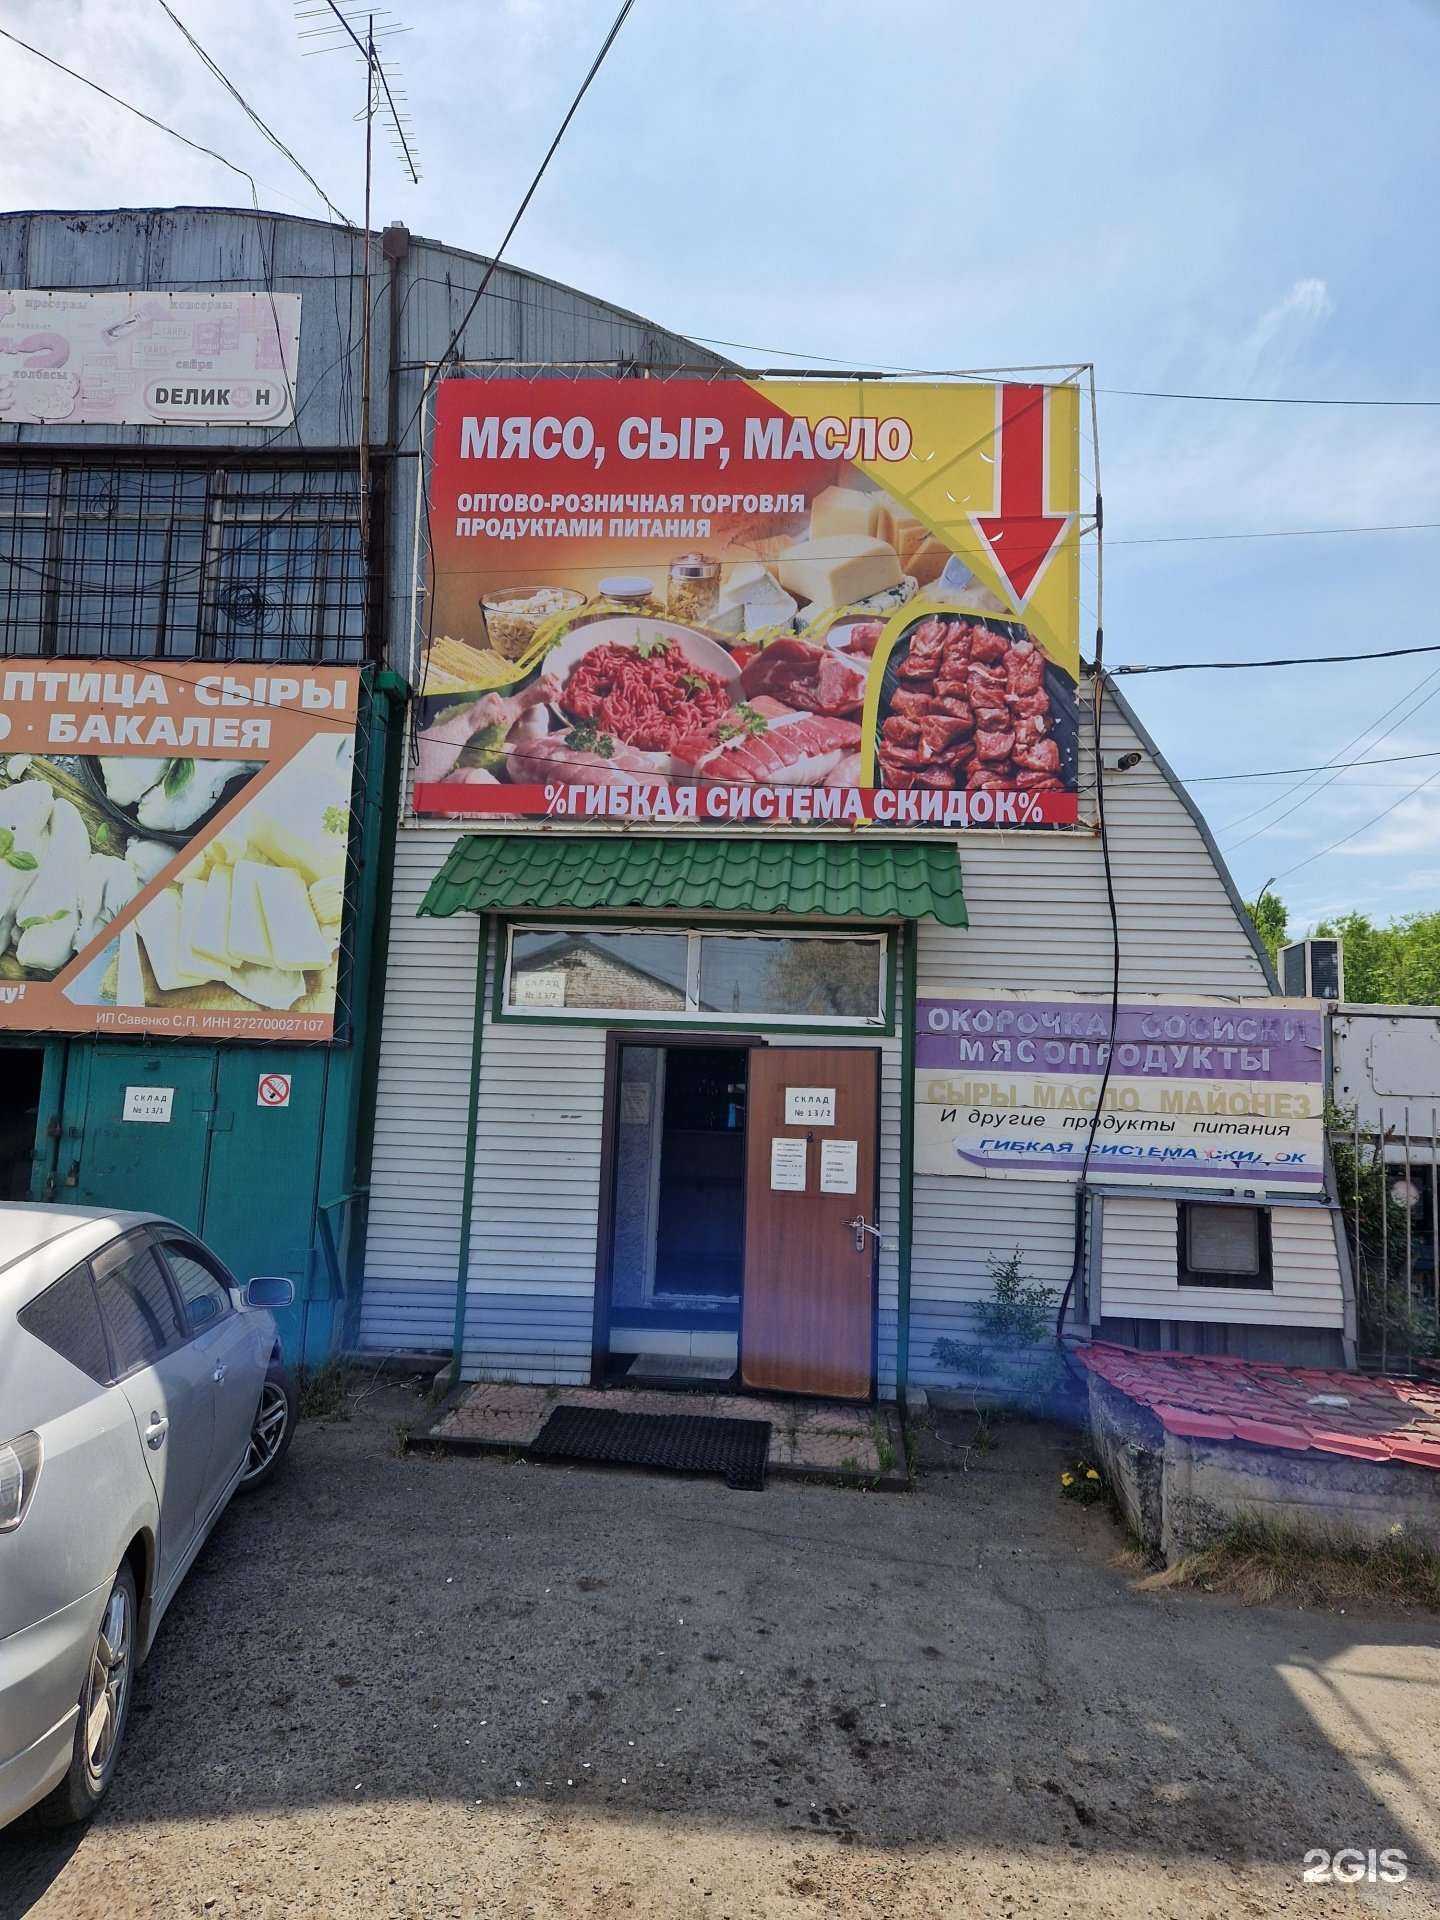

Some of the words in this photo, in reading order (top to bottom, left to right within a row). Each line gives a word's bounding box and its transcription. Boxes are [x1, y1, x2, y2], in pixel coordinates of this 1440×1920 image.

[460, 416, 606, 470] МЯСО,
[618, 416, 730, 470] СЫР,
[743, 416, 913, 461] МАСЛО
[457, 493, 684, 513] ОПТОВО-РОЗНИЧНАЯ
[690, 493, 805, 513] ТОРГОВЛЯ
[456, 517, 603, 539] ПРОДУКТАМИ
[608, 518, 711, 538] ПИТАНИЯ
[3, 672, 169, 709] ПТИЦА
[194, 676, 347, 709] СЫРЫ
[48, 713, 272, 749] БАКАЛЕЯ
[706, 786, 865, 820] СИСТЕМА
[96, 1012, 115, 1024] ИП
[118, 1013, 170, 1026] Савенко
[173, 1015, 199, 1028] С.П.
[202, 1016, 231, 1029] ИНН
[928, 1008, 1108, 1036] ОКОРОЧКА
[1141, 1015, 1307, 1042] СОСИСКИ
[959, 1039, 1271, 1073] МЯСОПРОДУКТЫ
[132, 1106, 142, 1114] №
[145, 1107, 164, 1115] 13/1
[134, 1094, 168, 1103] СКЛАД
[794, 1096, 830, 1105] СКЛАД
[927, 1079, 1017, 1107] СЫРЫ
[1033, 1085, 1141, 1112] МАСЛО
[1160, 1084, 1312, 1119] МАЙОНЕЗ
[794, 1109, 804, 1117] №
[807, 1109, 831, 1117] 13/2
[940, 1109, 957, 1122] И
[968, 1109, 1046, 1128] другие
[1062, 1115, 1175, 1134] продукты
[1193, 1121, 1291, 1137] питания
[979, 1139, 1074, 1153] ГИБКАЯ
